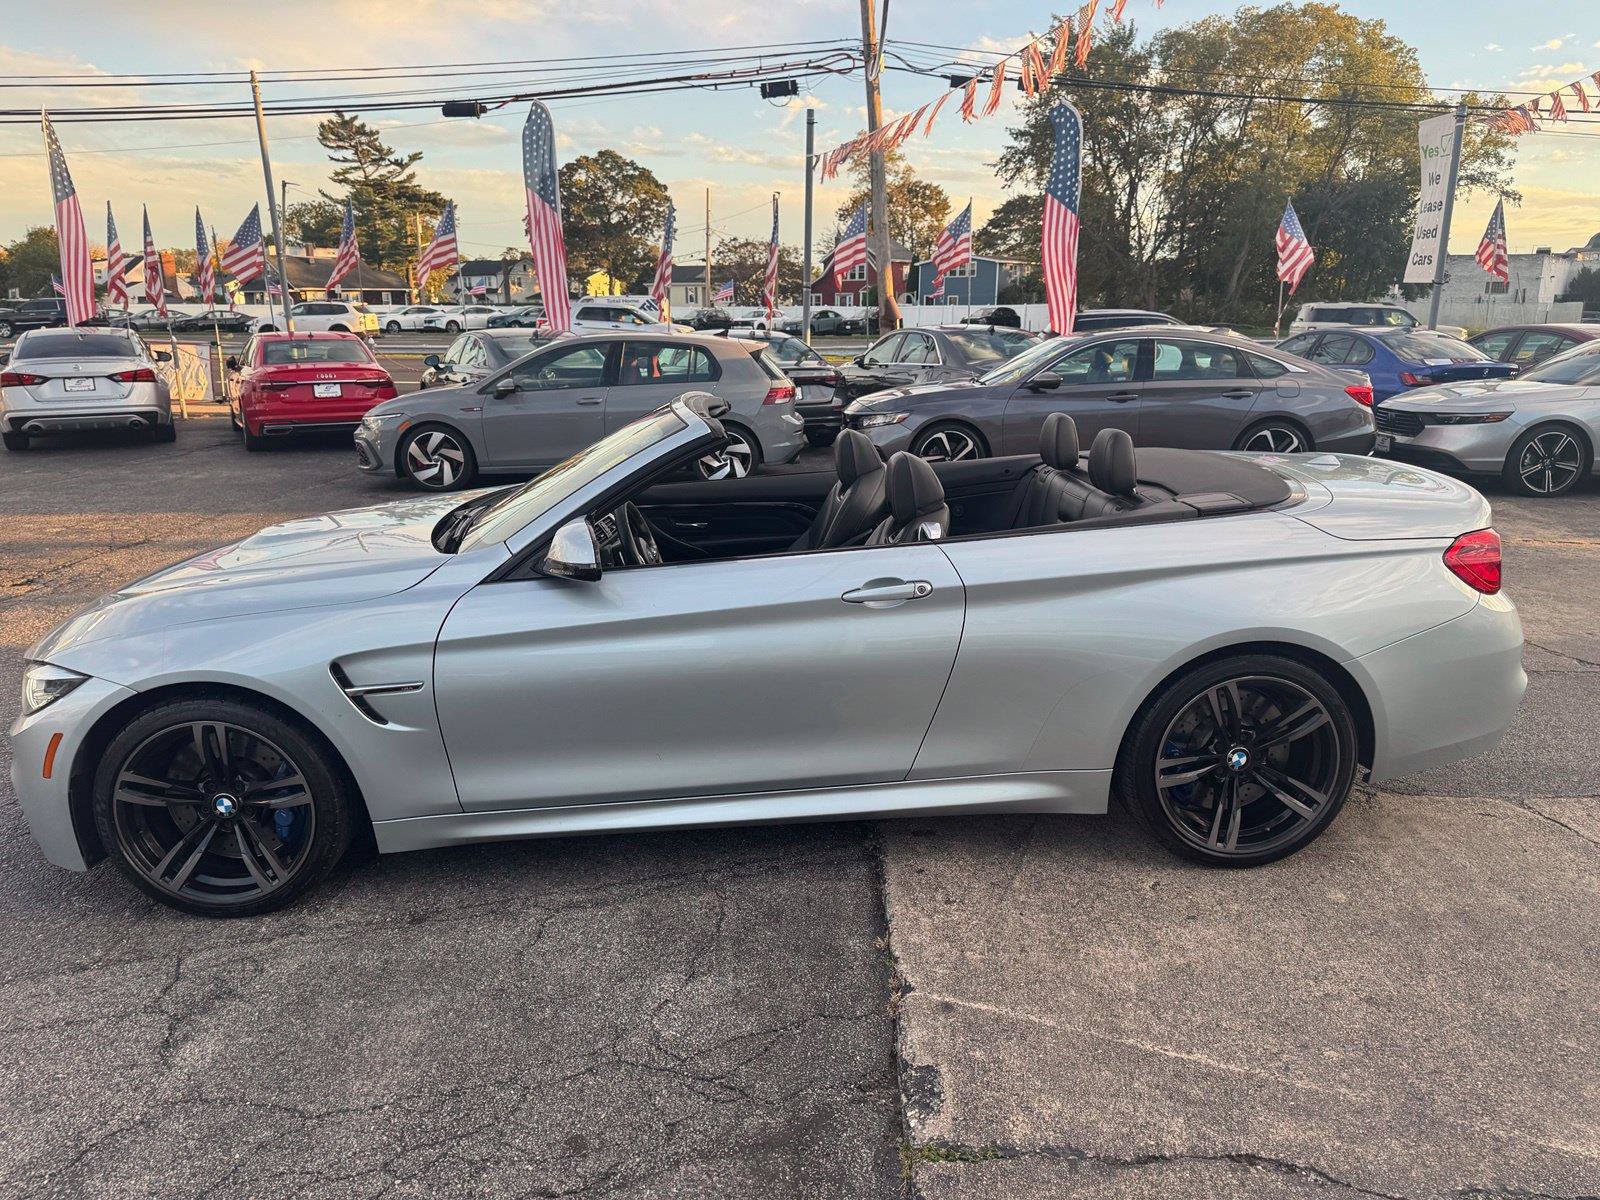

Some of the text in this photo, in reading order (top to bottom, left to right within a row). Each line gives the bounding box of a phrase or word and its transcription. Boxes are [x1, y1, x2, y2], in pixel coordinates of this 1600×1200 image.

[1421, 145, 1440, 159] Yes
[1428, 172, 1441, 186] We
[1419, 200, 1443, 215] Lease
[1416, 226, 1438, 240] Used
[1412, 252, 1433, 266] Cars
